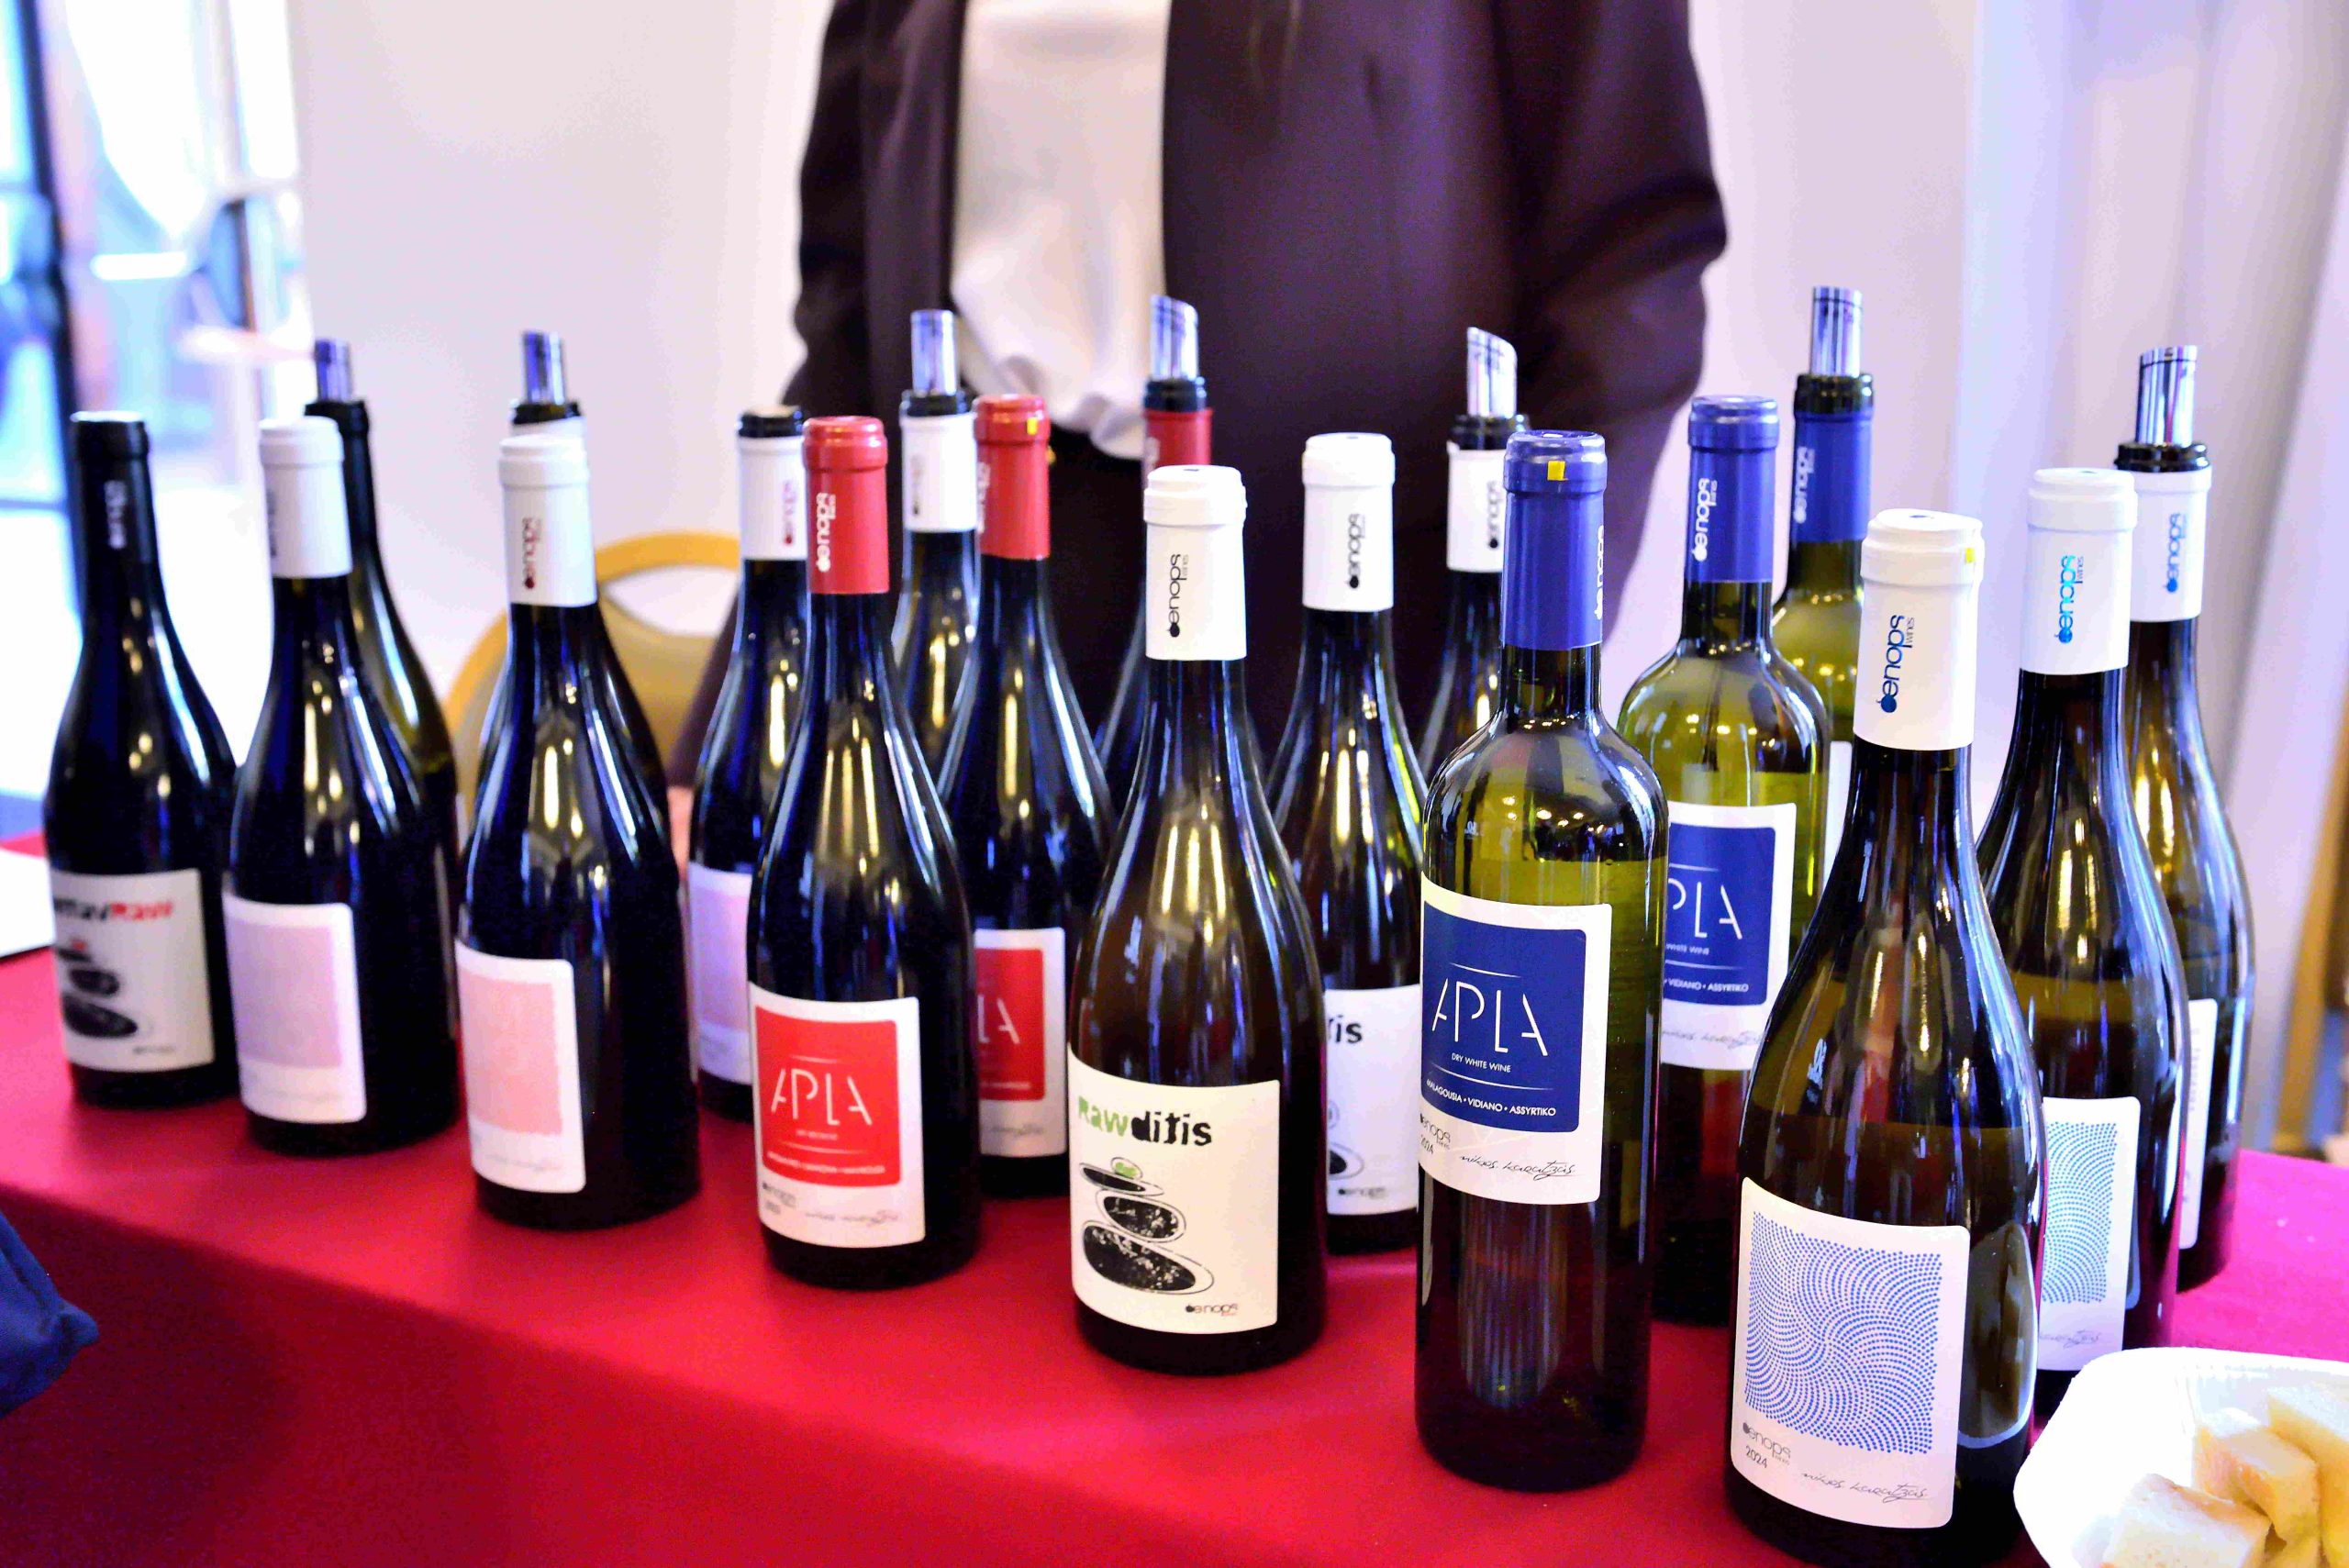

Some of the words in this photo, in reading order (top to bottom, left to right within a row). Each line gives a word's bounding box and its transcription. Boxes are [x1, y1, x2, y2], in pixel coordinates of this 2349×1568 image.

[1668, 878, 1742, 940] PLA
[977, 994, 1020, 1045] LA
[1431, 977, 1548, 1057] APLA
[1452, 1052, 1464, 1063] DRY
[1465, 1056, 1487, 1071] WHITE
[1489, 1062, 1511, 1073] WINE
[770, 1068, 873, 1126] APLA
[1426, 1078, 1463, 1103] MALAGOUSIA
[1468, 1097, 1503, 1112] VIDIANO
[1509, 1106, 1556, 1117] ASSYRTIKO
[1746, 1445, 1767, 1468] 2024
